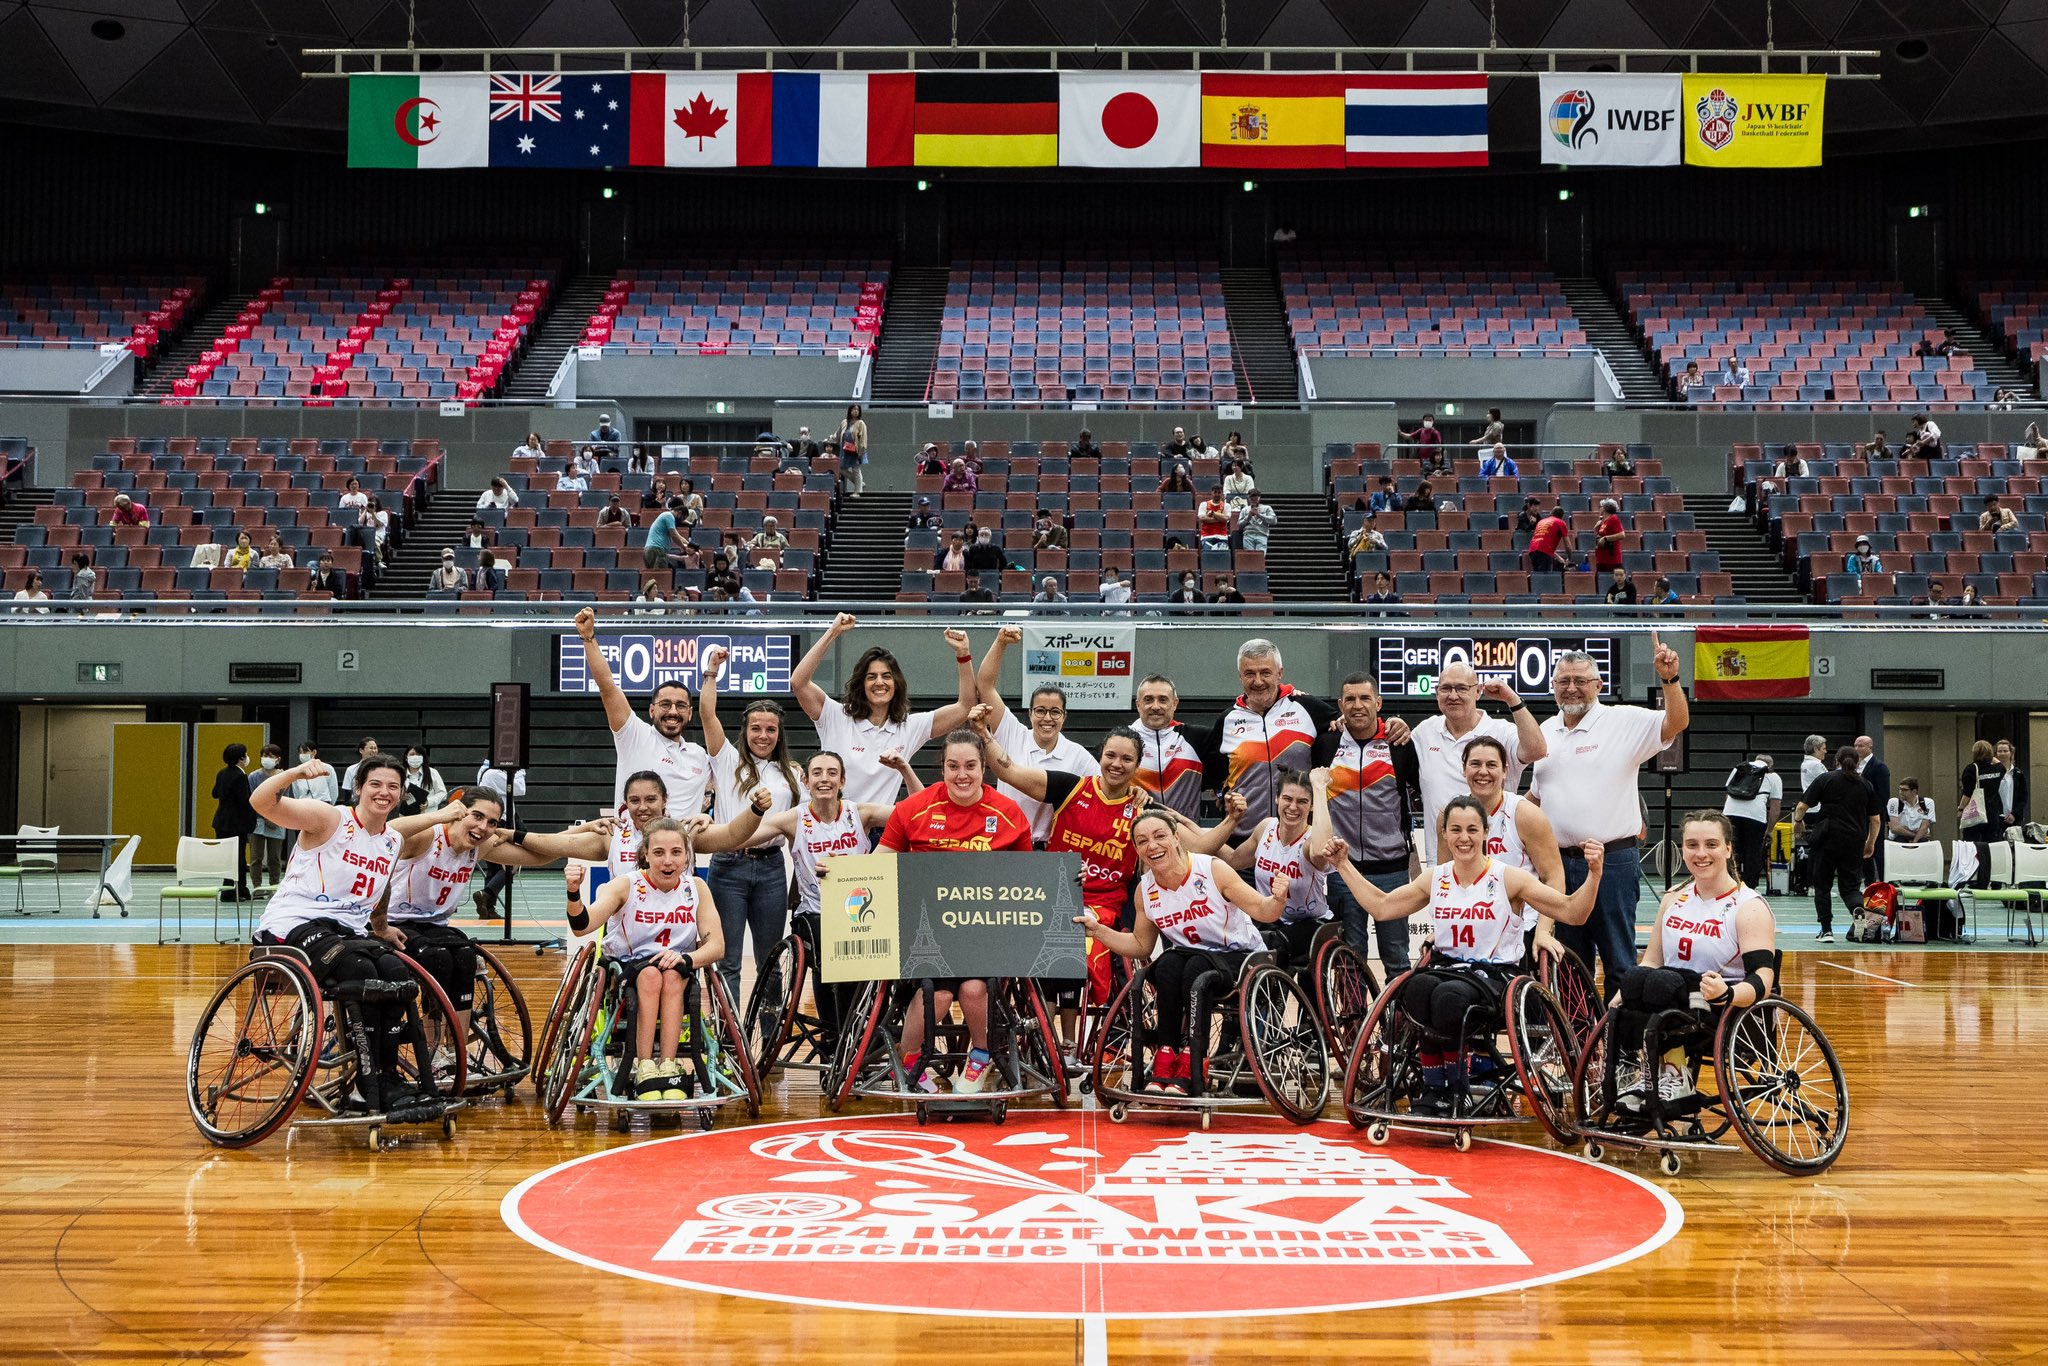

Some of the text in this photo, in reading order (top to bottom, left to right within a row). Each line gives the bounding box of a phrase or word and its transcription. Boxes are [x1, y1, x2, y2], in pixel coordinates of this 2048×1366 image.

[1608, 109, 1675, 131] IWBF
[1742, 104, 1810, 121] JWBF
[1045, 633, 1115, 648] スポーツくじ
[342, 652, 354, 668] 2
[655, 639, 697, 663] 31:00
[732, 646, 766, 662] FRA
[1404, 649, 1438, 665] GER
[1474, 642, 1516, 667] 31:00
[624, 643, 651, 683] 0
[1029, 664, 1056, 672] WINNER
[1520, 646, 1547, 686] 0
[1818, 658, 1829, 674] 3
[659, 671, 692, 686] INT
[755, 674, 764, 690] 0
[1419, 677, 1429, 692] 0
[495, 692, 502, 702] T
[1656, 697, 1664, 706] T
[929, 821, 945, 830] vive
[1112, 818, 1131, 841] 44
[808, 830, 858, 853] ESPAÑA
[928, 836, 993, 851] ESPAÑA
[1063, 829, 1127, 861] ESPAÑA
[1257, 856, 1303, 879] ESPAÑA
[350, 872, 375, 898] 21
[937, 886, 1046, 901] PARIS 2024
[435, 886, 452, 906] 8
[635, 905, 696, 924] ESPAÑA
[941, 911, 1044, 927] QUALIFIED
[1155, 896, 1215, 929] ESPAÑA
[1435, 900, 1496, 920] ESPAÑA
[1183, 926, 1201, 945] 6
[1451, 924, 1475, 948] 14
[1666, 915, 1723, 939] ESPAÑA
[302, 932, 322, 947] vive
[654, 928, 671, 947] 4
[1678, 937, 1693, 961] 9
[697, 1192, 1497, 1225] OSAKA
[696, 1225, 1487, 1242] 2024 IWBF Women's
[685, 1241, 1501, 1259] Repechage Tournament
